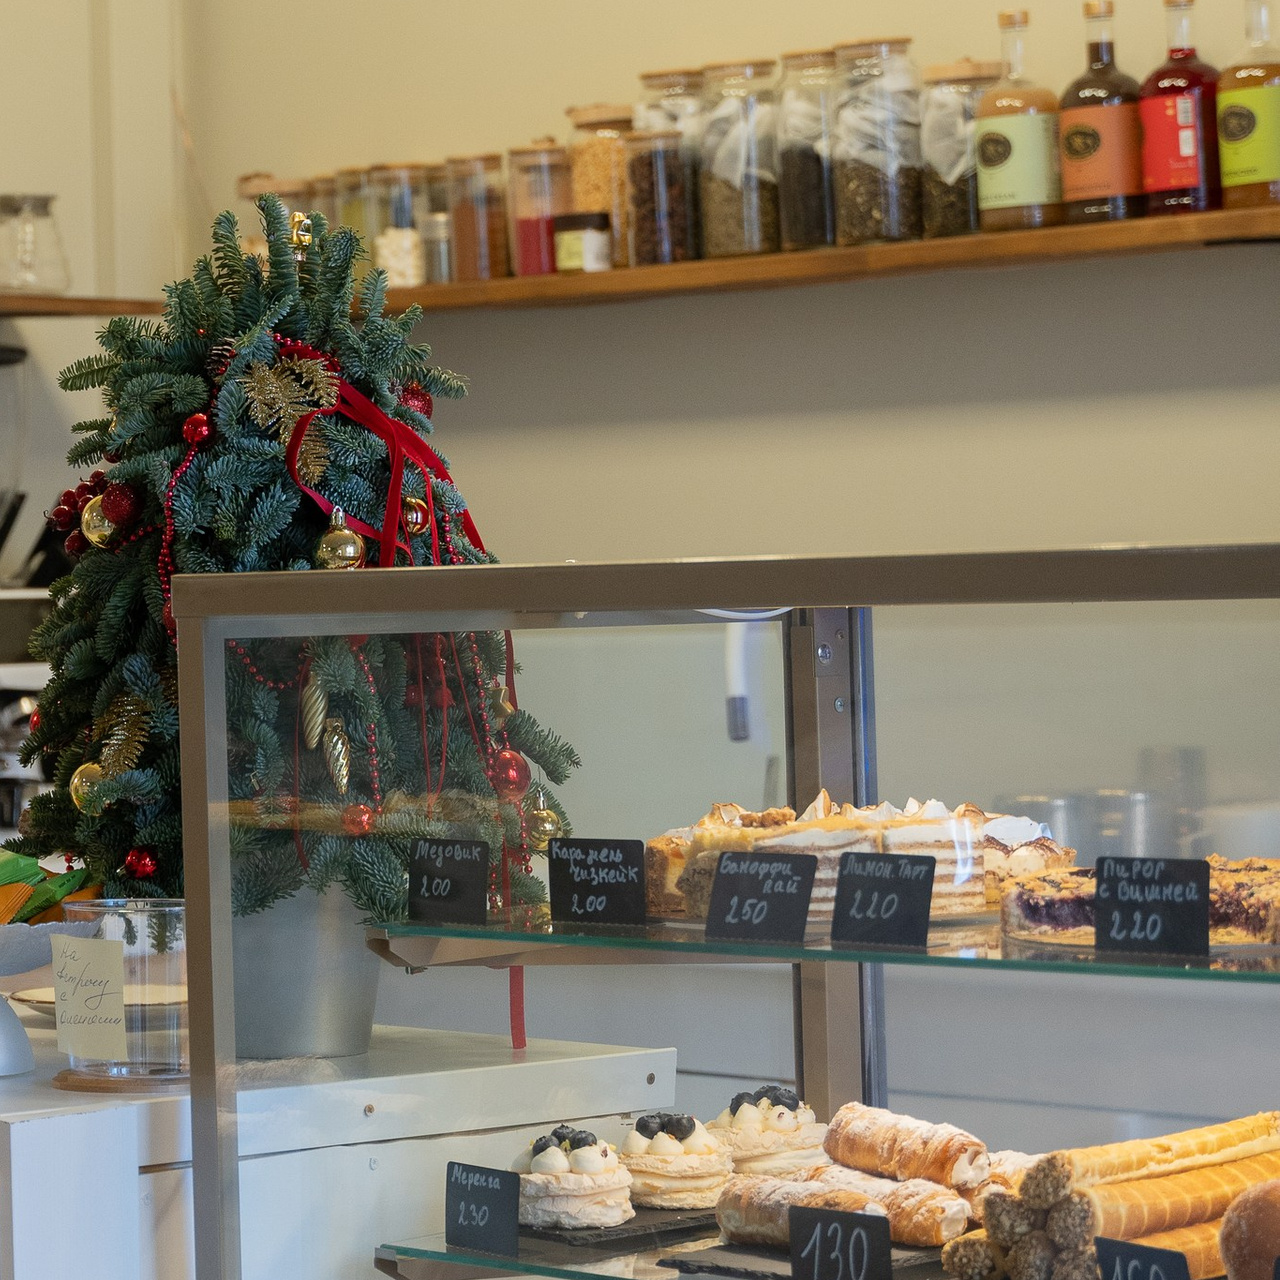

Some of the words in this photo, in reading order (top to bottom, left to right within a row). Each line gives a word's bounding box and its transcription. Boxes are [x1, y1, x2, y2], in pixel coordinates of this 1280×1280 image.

[415, 840, 481, 867] Медовик
[420, 875, 451, 898] 200
[571, 894, 606, 914] 200
[725, 896, 768, 924] 250
[849, 889, 898, 919] 220
[1109, 911, 1161, 940] 220
[458, 1201, 489, 1227] 230
